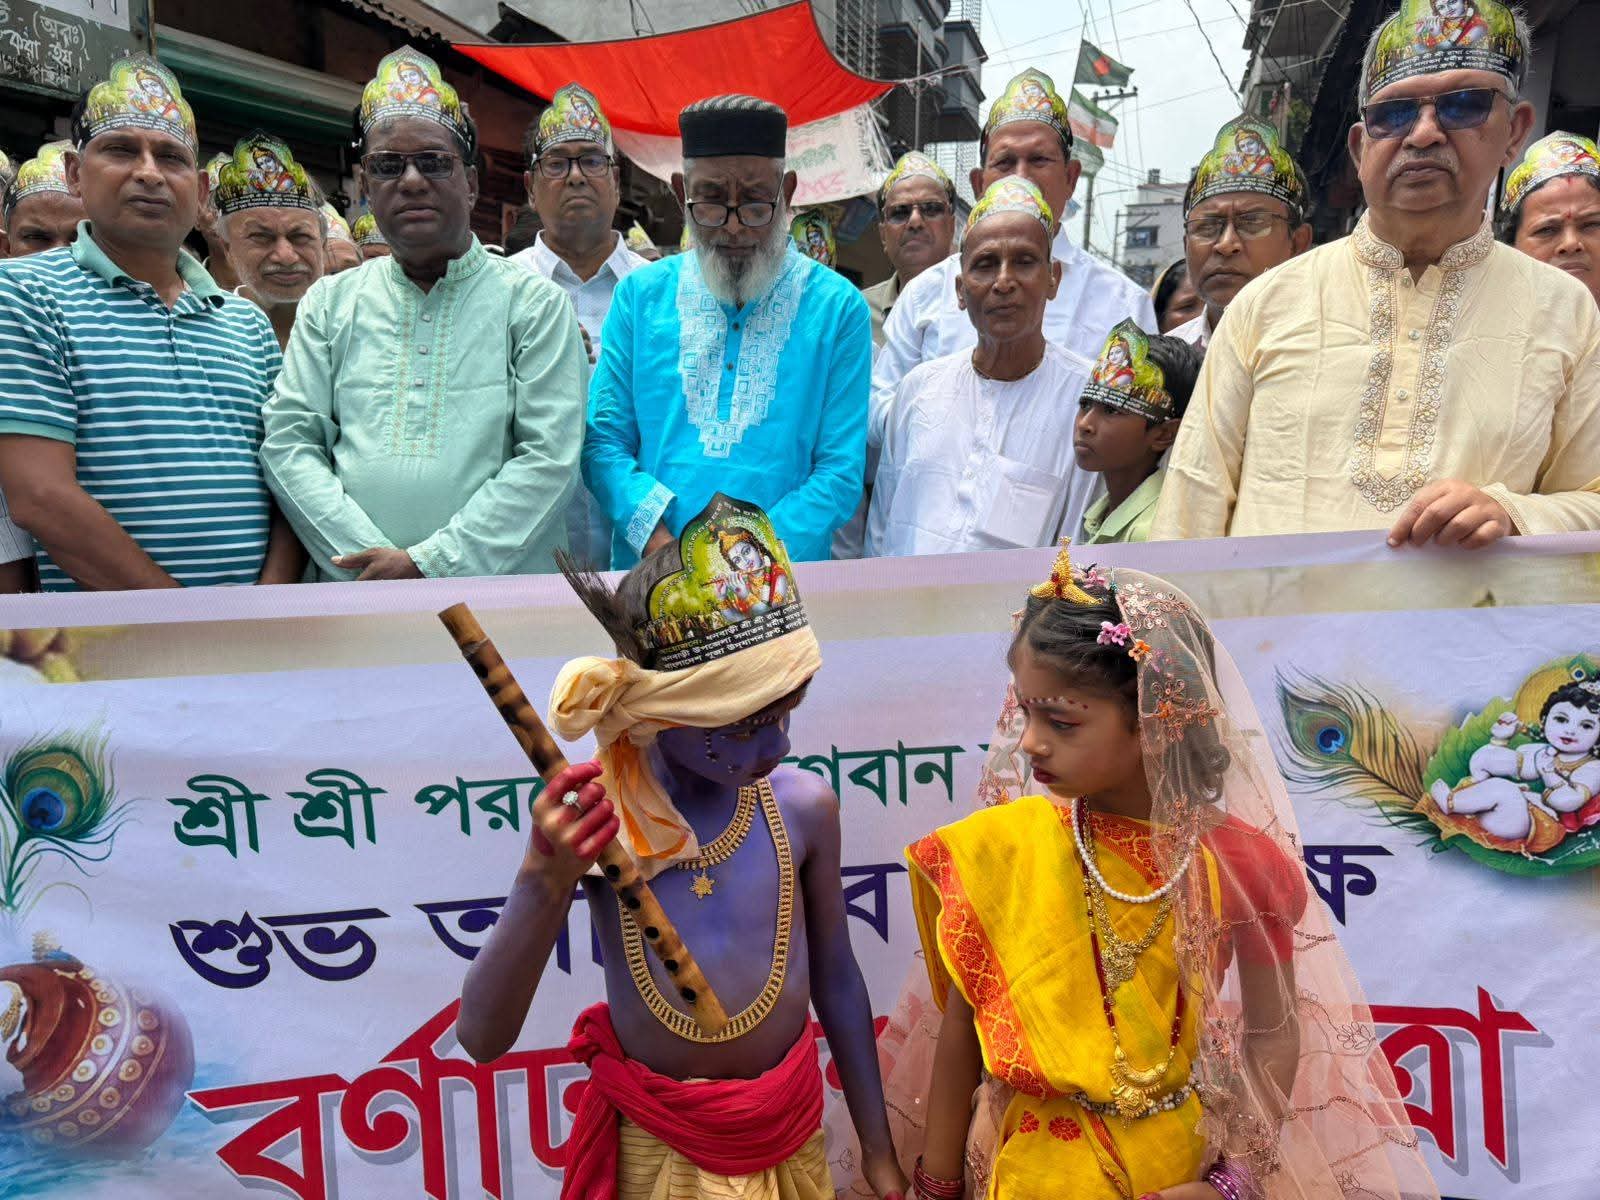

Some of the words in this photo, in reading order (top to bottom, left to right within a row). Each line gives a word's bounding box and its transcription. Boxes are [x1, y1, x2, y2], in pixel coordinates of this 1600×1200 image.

[166, 774, 271, 859] শ্রী
[285, 768, 389, 850] শ্রী
[780, 739, 967, 808] গবান
[168, 908, 392, 990] শুভ
